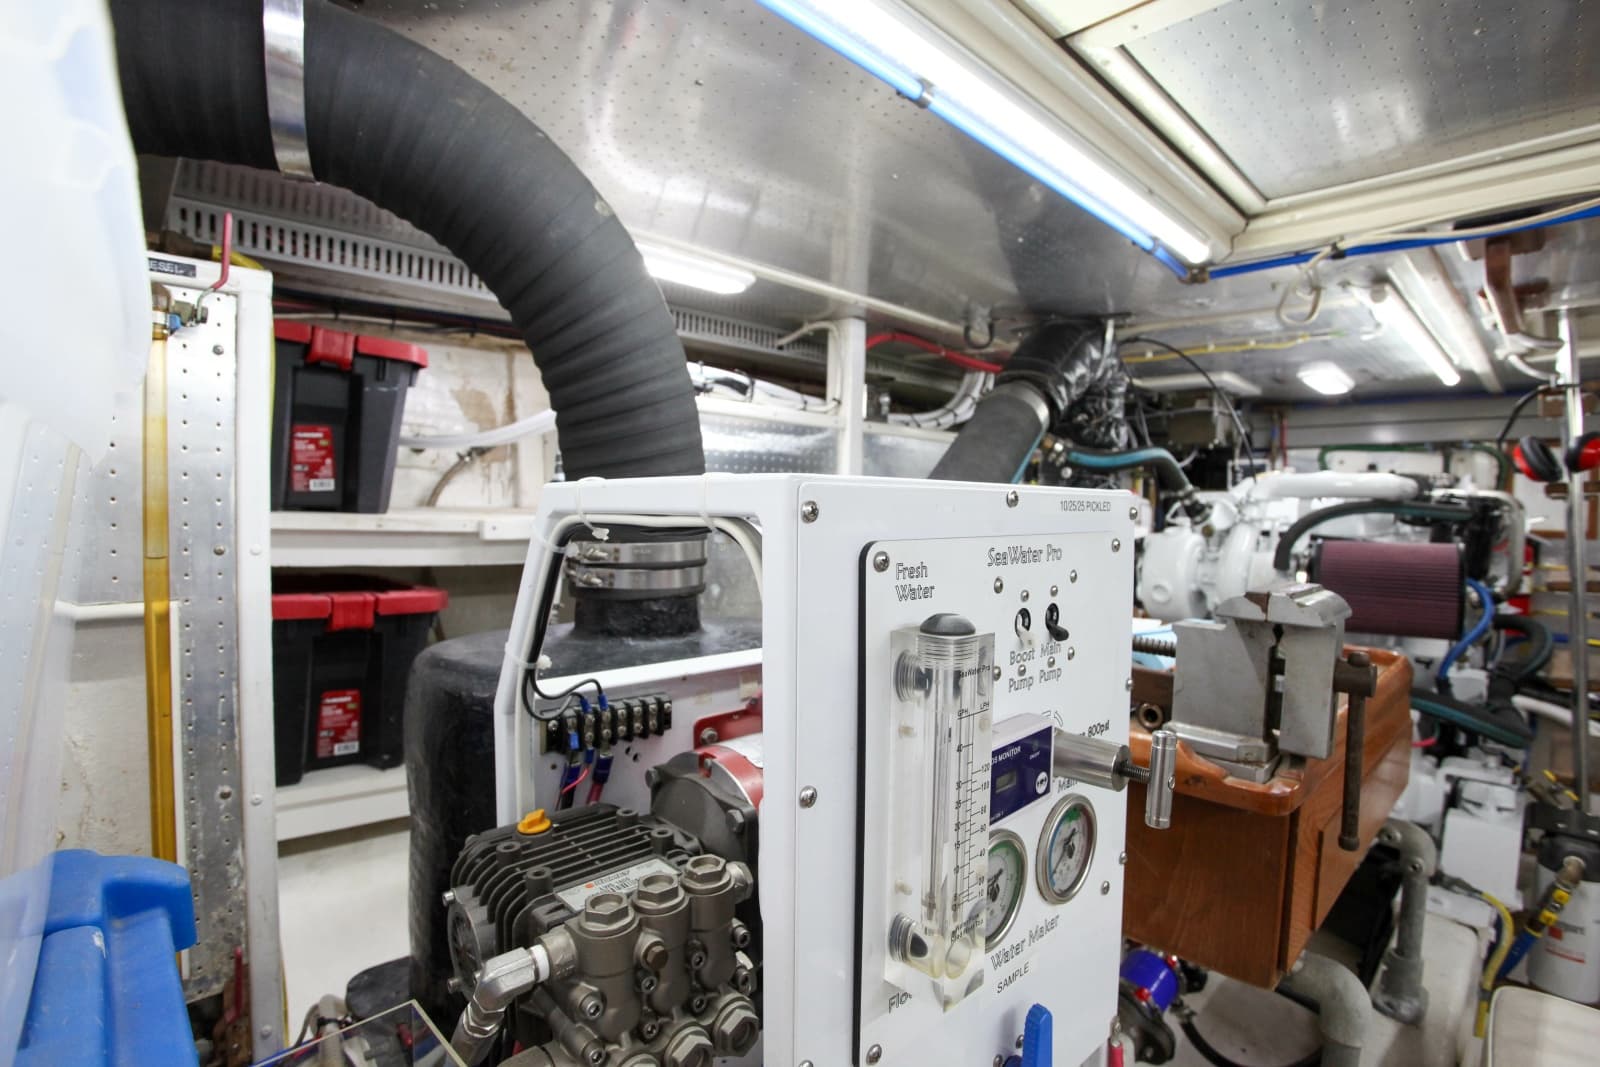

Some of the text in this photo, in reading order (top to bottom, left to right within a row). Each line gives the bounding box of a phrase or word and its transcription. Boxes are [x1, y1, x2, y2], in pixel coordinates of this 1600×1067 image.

[150, 260, 184, 274] ESEL
[1060, 500, 1111, 512] 10/25/25 PICKLED
[987, 543, 1062, 567] SeaWater Pro
[895, 561, 928, 581] Fresh
[894, 583, 935, 602] Water
[1009, 647, 1035, 666] Boost
[1039, 641, 1062, 658] Main
[1008, 676, 1034, 693] Pump
[1039, 667, 1062, 684] Pump
[998, 746, 1021, 761] MONITOR
[990, 914, 1060, 971] Water Maker
[996, 962, 1030, 994] SAMPLE
[888, 991, 913, 1014] Flo
